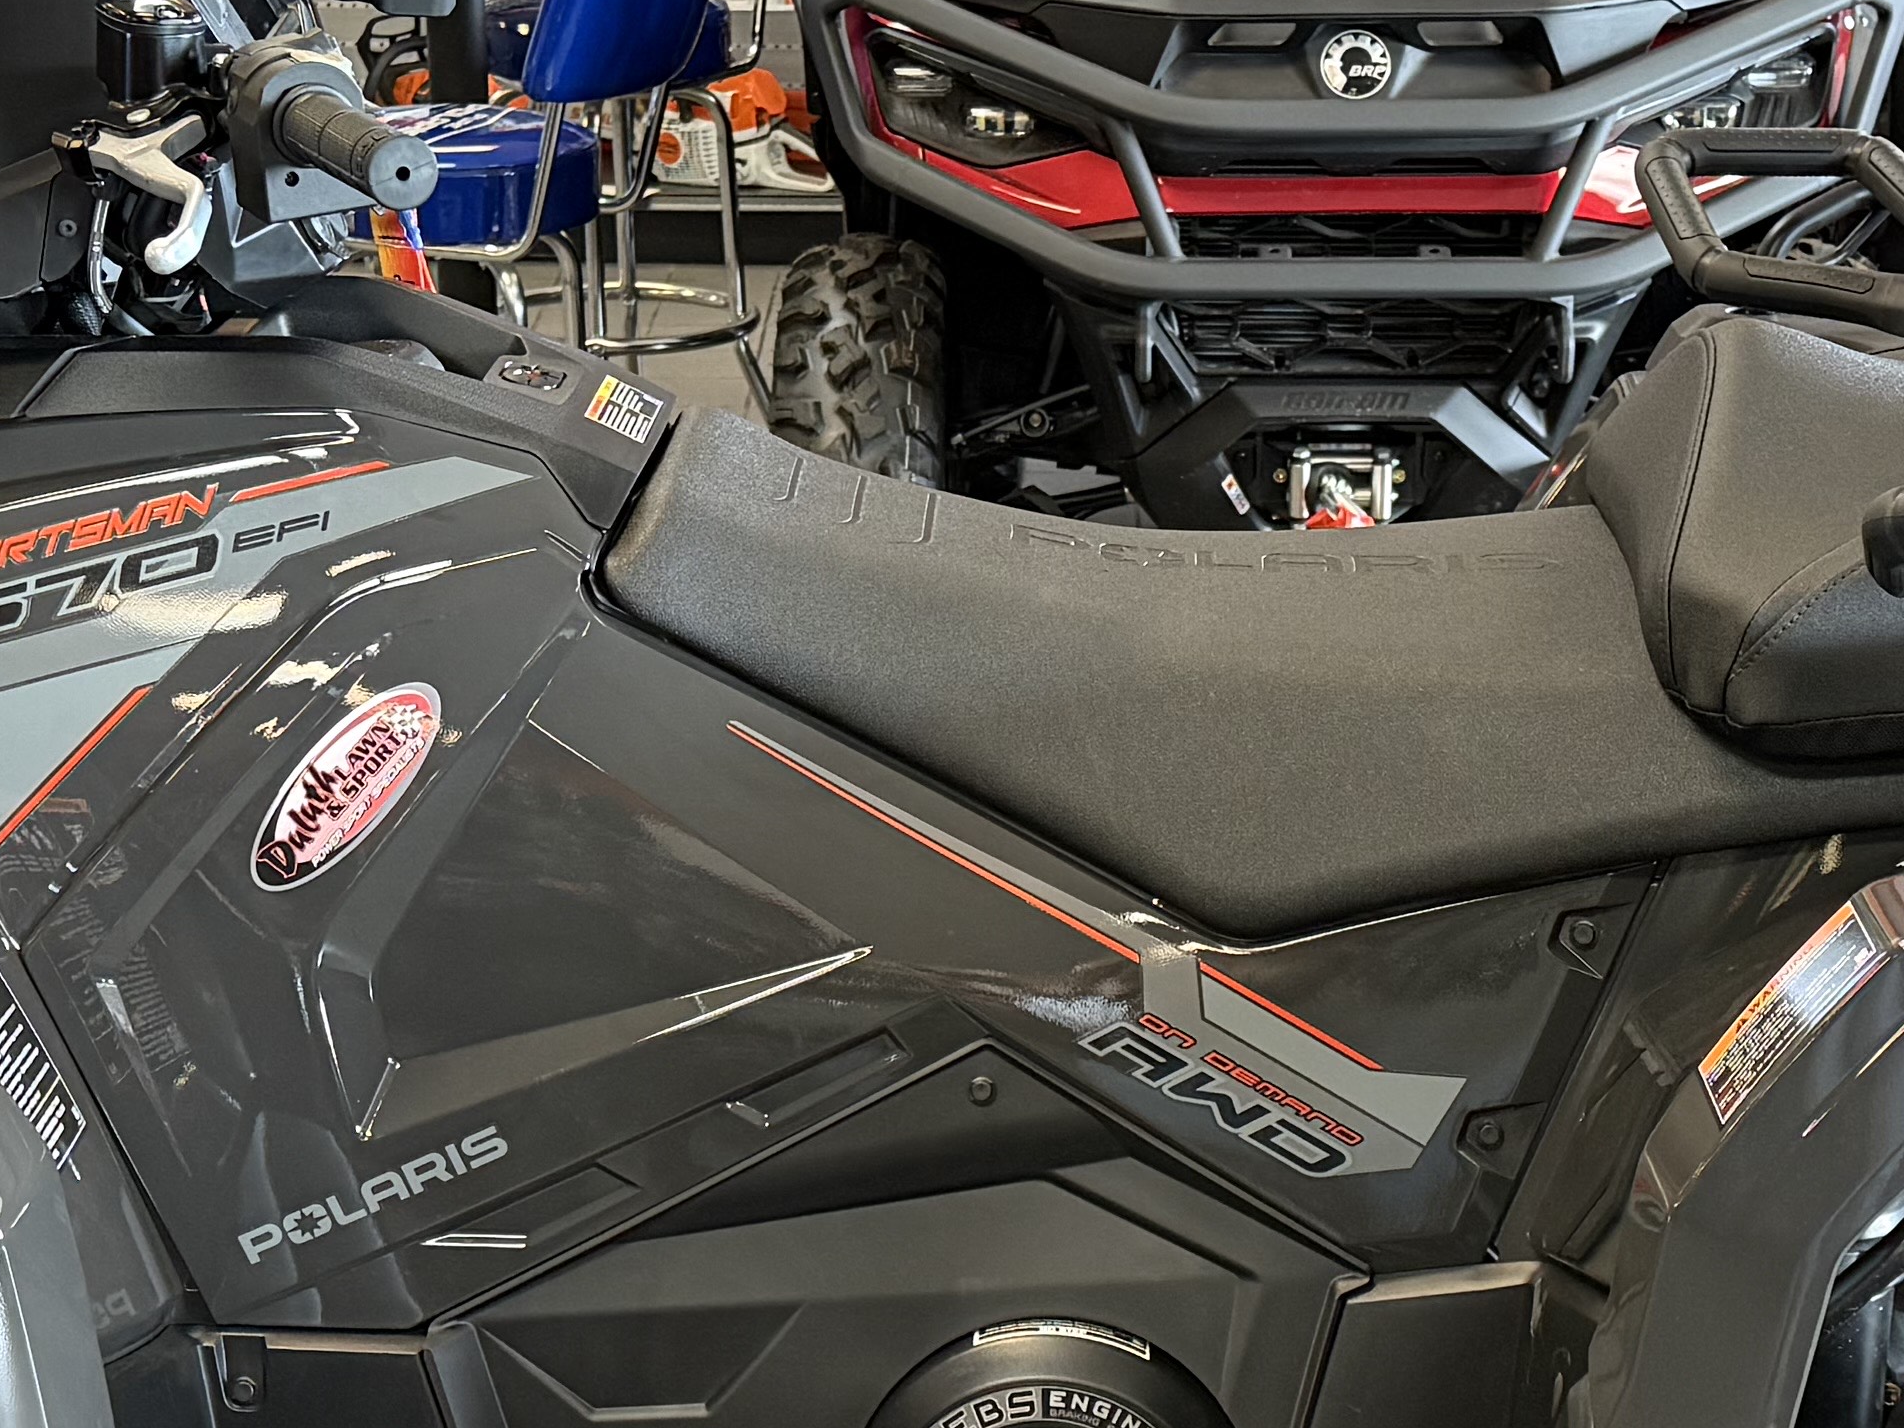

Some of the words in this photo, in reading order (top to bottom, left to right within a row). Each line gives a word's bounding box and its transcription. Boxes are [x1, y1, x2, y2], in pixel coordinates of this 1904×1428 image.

[1349, 65, 1388, 80] BRP
[232, 510, 332, 554] EFI
[326, 799, 348, 821] &
[341, 729, 404, 800] SPORT
[337, 719, 391, 783] LAWN
[257, 760, 337, 879] Duluth
[311, 828, 344, 868] POWER
[1088, 1024, 1352, 1175] AWD
[1203, 1049, 1364, 1148] DEMAND
[236, 1125, 509, 1264] POLARIS
[1049, 1408, 1102, 1428] BRAKING
